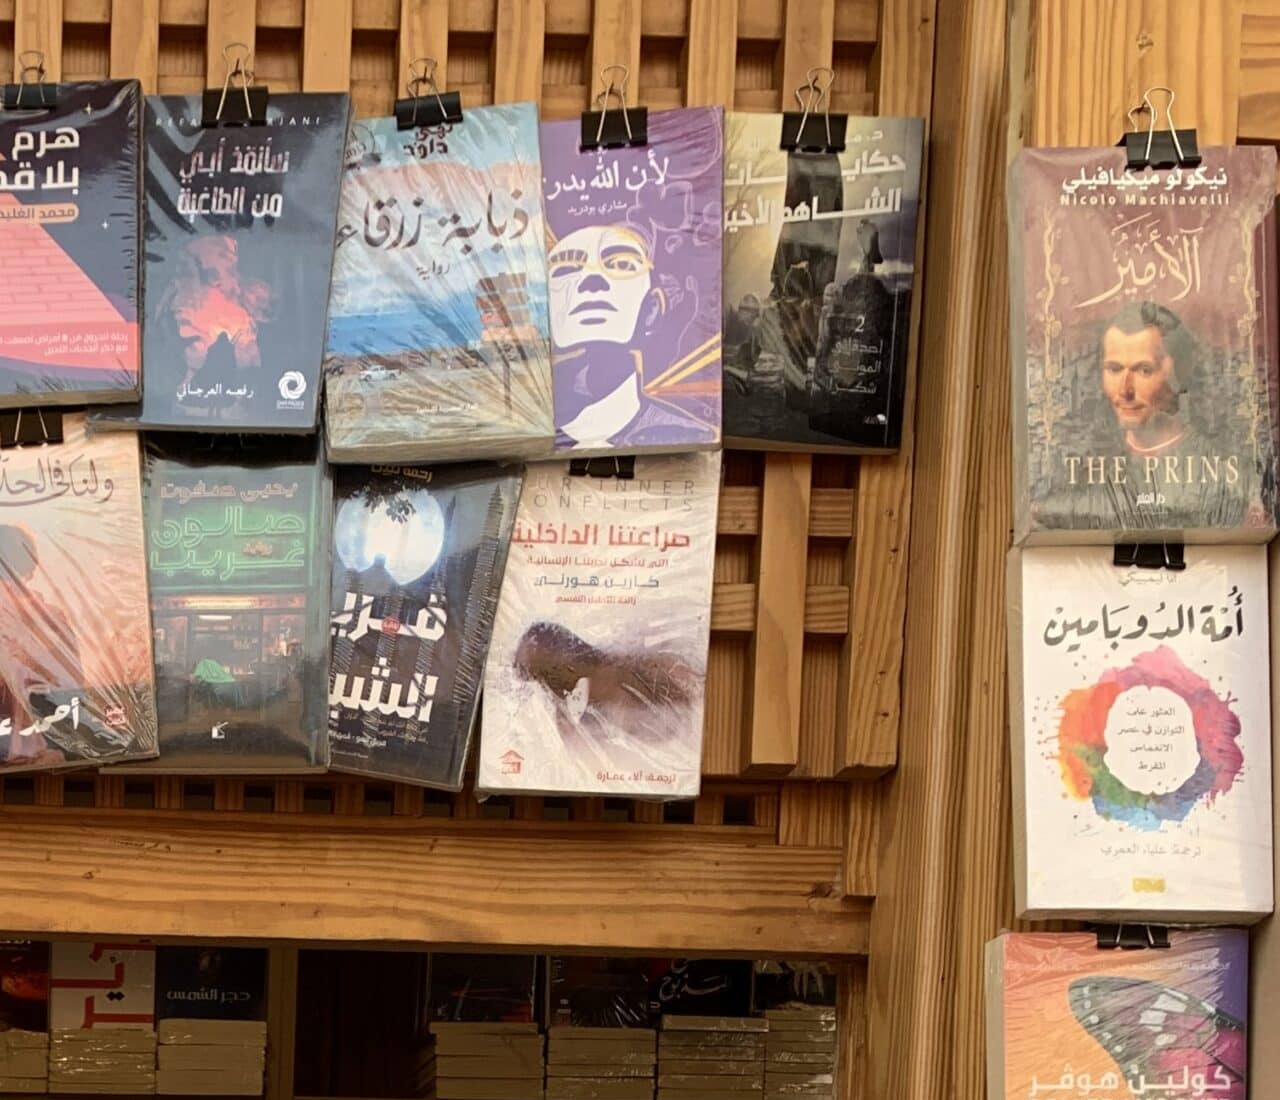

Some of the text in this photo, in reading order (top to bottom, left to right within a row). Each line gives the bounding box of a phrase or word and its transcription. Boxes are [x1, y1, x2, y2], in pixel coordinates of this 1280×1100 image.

[11, 125, 80, 160] هرم
[625, 149, 669, 191] لأن
[38, 206, 76, 220] محمد
[176, 187, 284, 223] من الطاغية
[1060, 194, 1231, 206] Nicolo Machiavelli
[1066, 455, 1240, 485] THE PRINS
[533, 494, 694, 512] ONFLICTS
[151, 505, 306, 549] صالون
[150, 540, 305, 582] غريب
